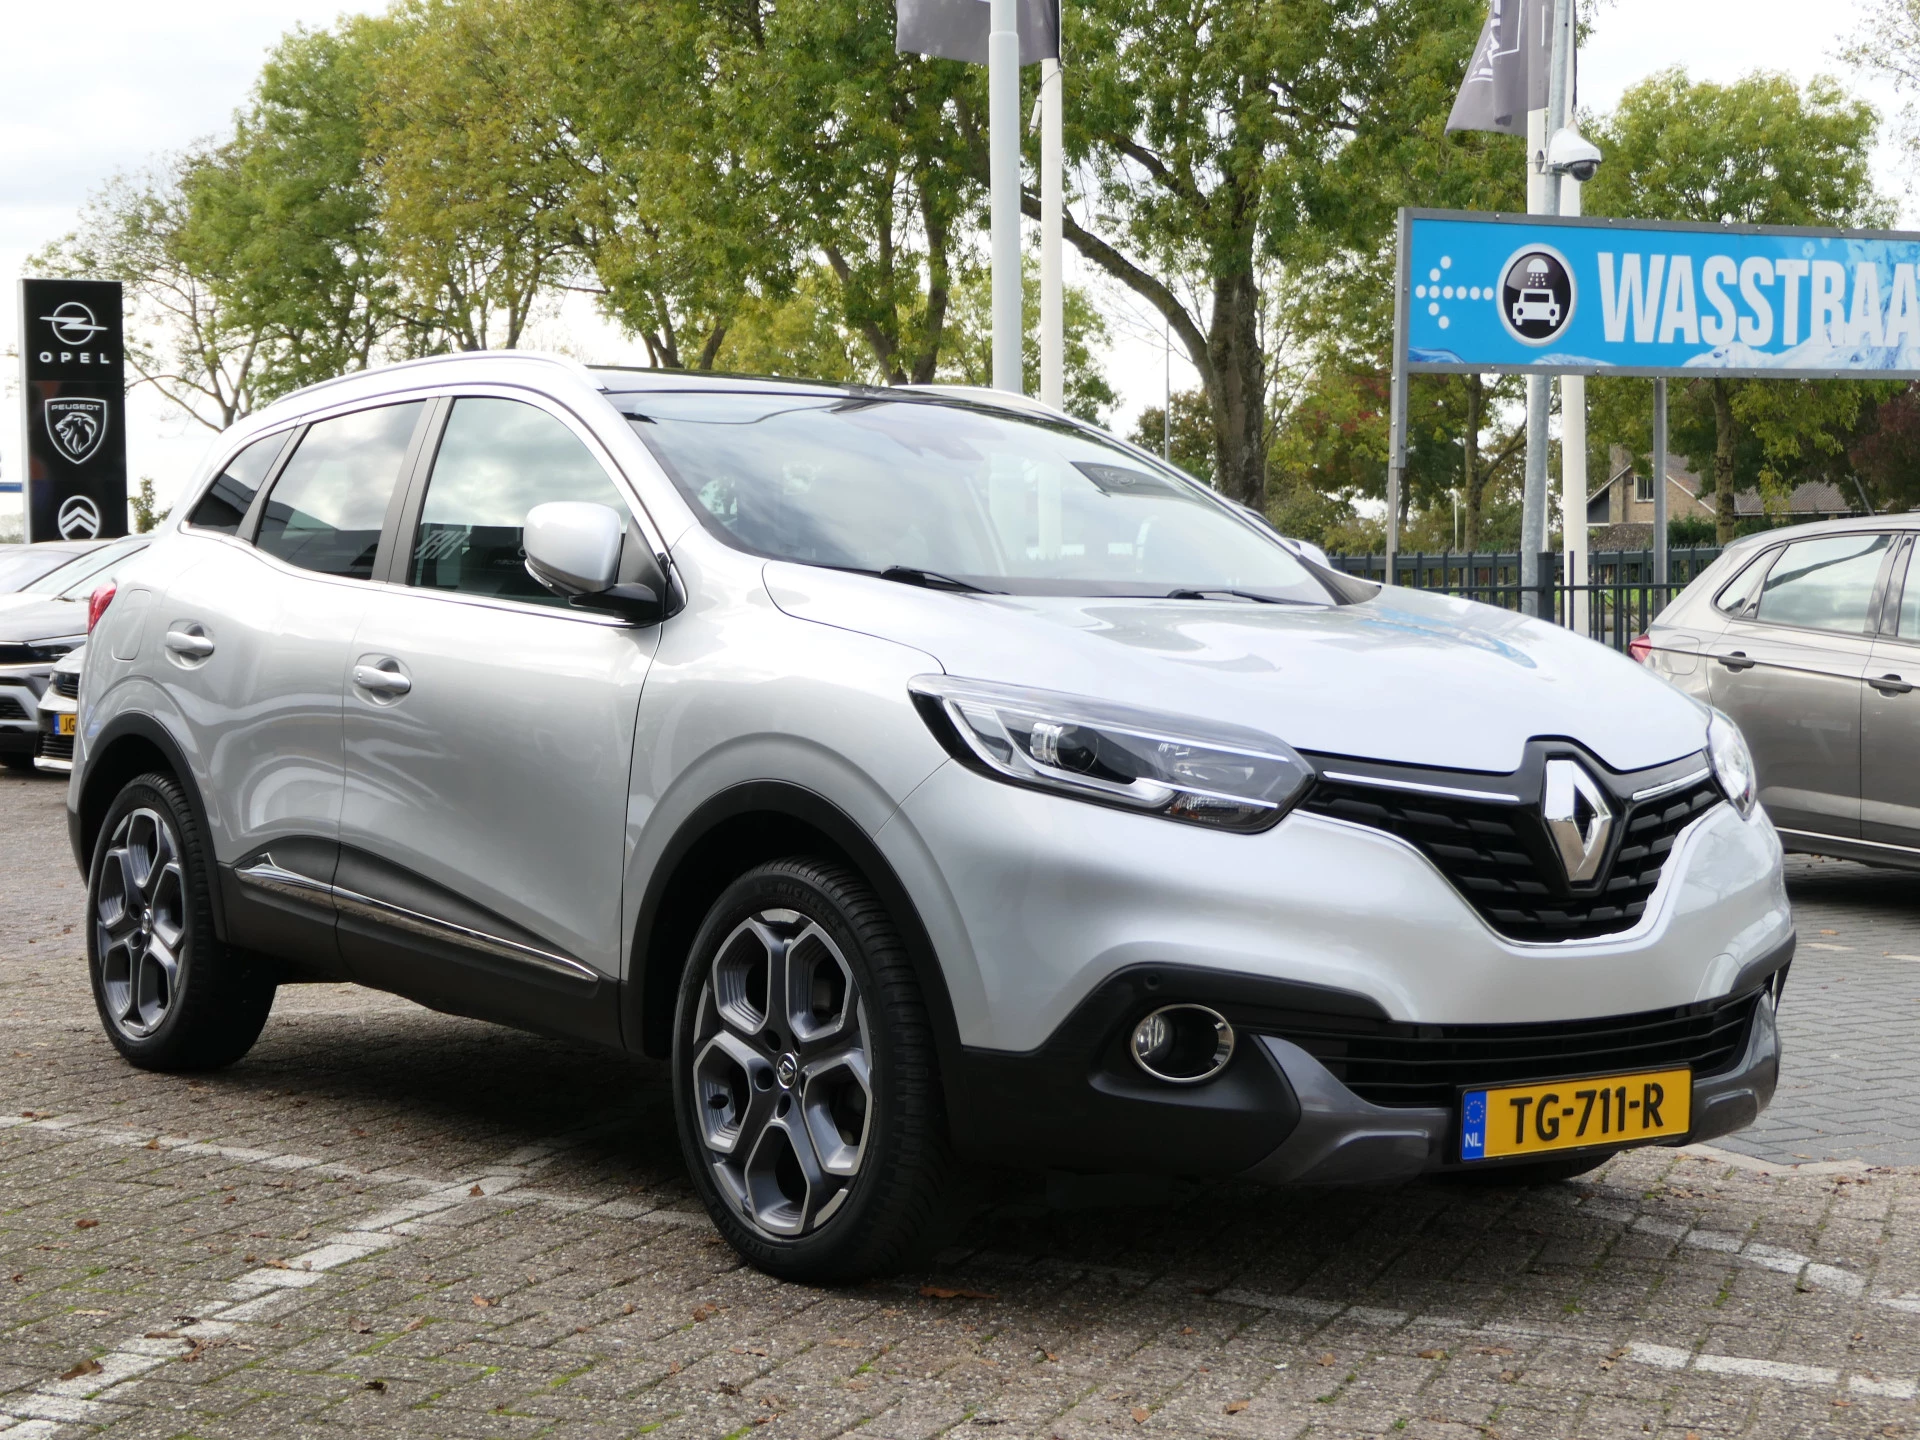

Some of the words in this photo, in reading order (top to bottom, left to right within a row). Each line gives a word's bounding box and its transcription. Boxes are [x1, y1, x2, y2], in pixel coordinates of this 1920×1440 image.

[1597, 252, 1920, 347] WASSTRAA
[40, 351, 110, 364] OPEL
[51, 403, 100, 411] PEUGEOT
[1509, 1083, 1664, 1144] TG-711-R
[1464, 1132, 1481, 1148] NL
